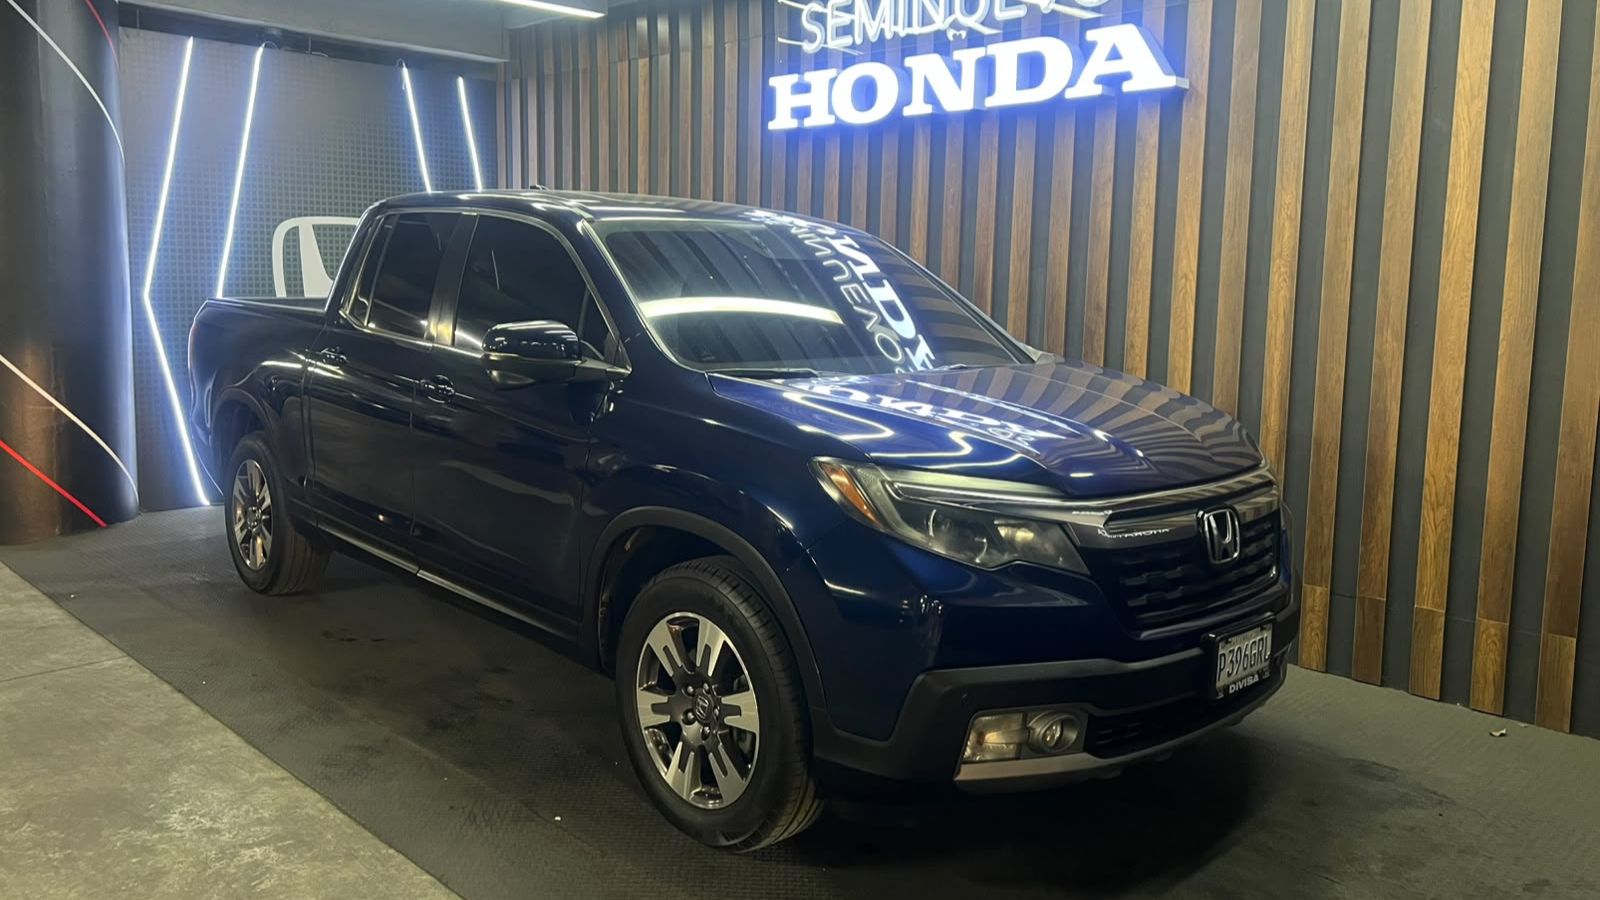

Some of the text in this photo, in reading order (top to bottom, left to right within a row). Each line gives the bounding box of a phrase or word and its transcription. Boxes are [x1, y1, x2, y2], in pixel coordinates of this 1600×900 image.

[768, 23, 1179, 131] HONDA
[1217, 634, 1272, 682] P396GRL
[1229, 674, 1260, 695] DIVISA
